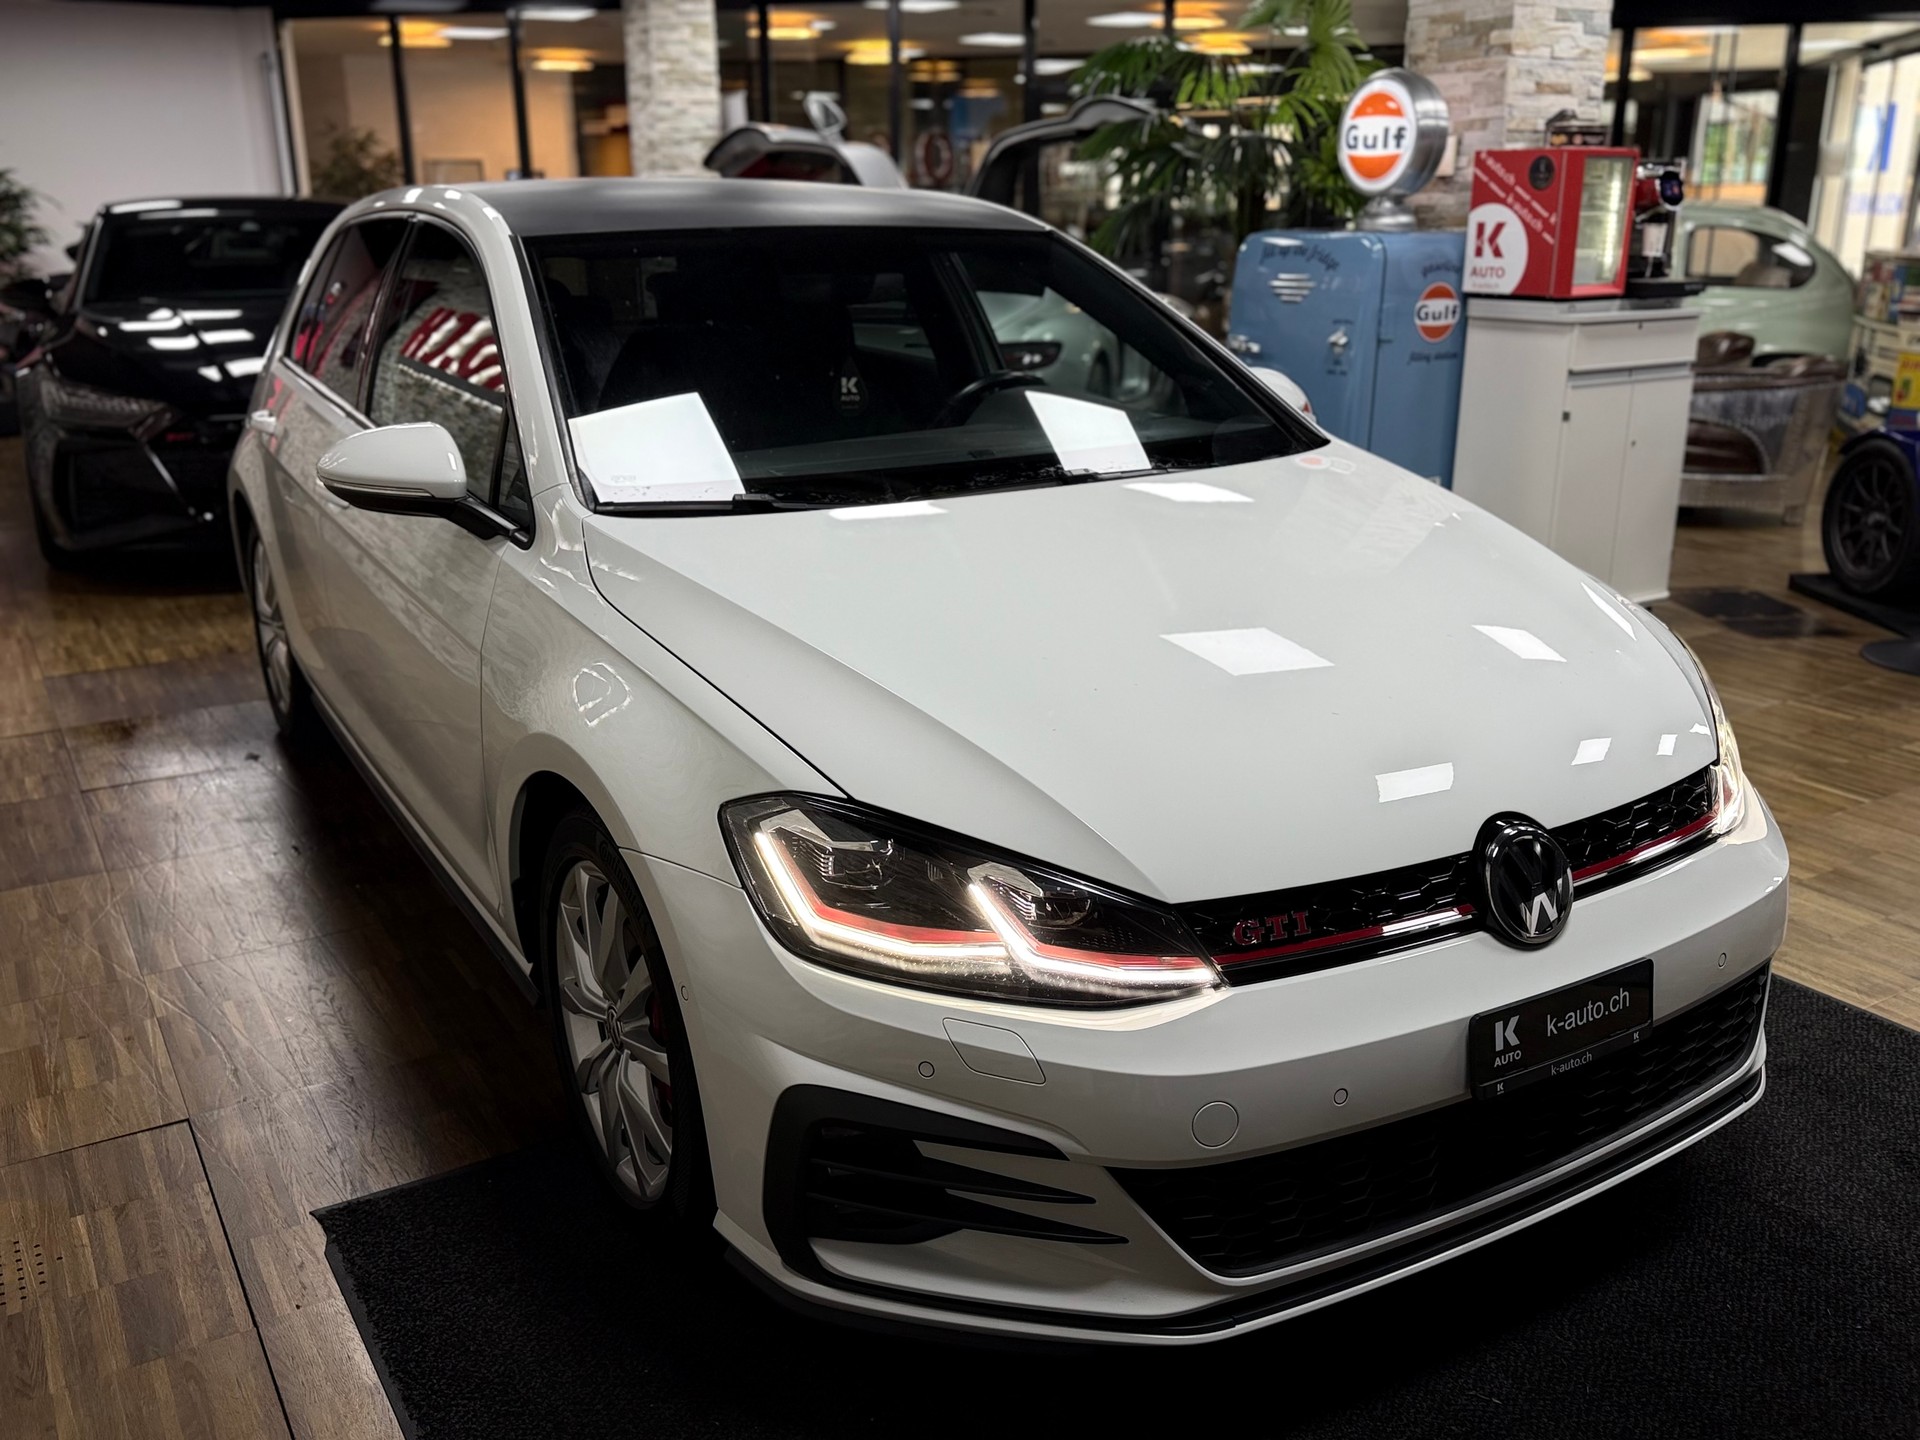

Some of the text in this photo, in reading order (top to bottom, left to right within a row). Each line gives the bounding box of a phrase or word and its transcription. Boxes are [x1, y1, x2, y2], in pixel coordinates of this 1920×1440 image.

[1345, 126, 1408, 150] Gulf
[1474, 222, 1506, 258] K
[1470, 266, 1505, 280] AUTO
[1416, 304, 1458, 321] Gulf
[841, 377, 858, 393] K
[1233, 910, 1311, 945] GTI
[1546, 987, 1630, 1037] k-auto.ch
[1494, 1015, 1521, 1052] K
[1494, 1049, 1522, 1068] AUTO
[1551, 1051, 1593, 1076] k-auto.ch
[1497, 1081, 1504, 1092] K
